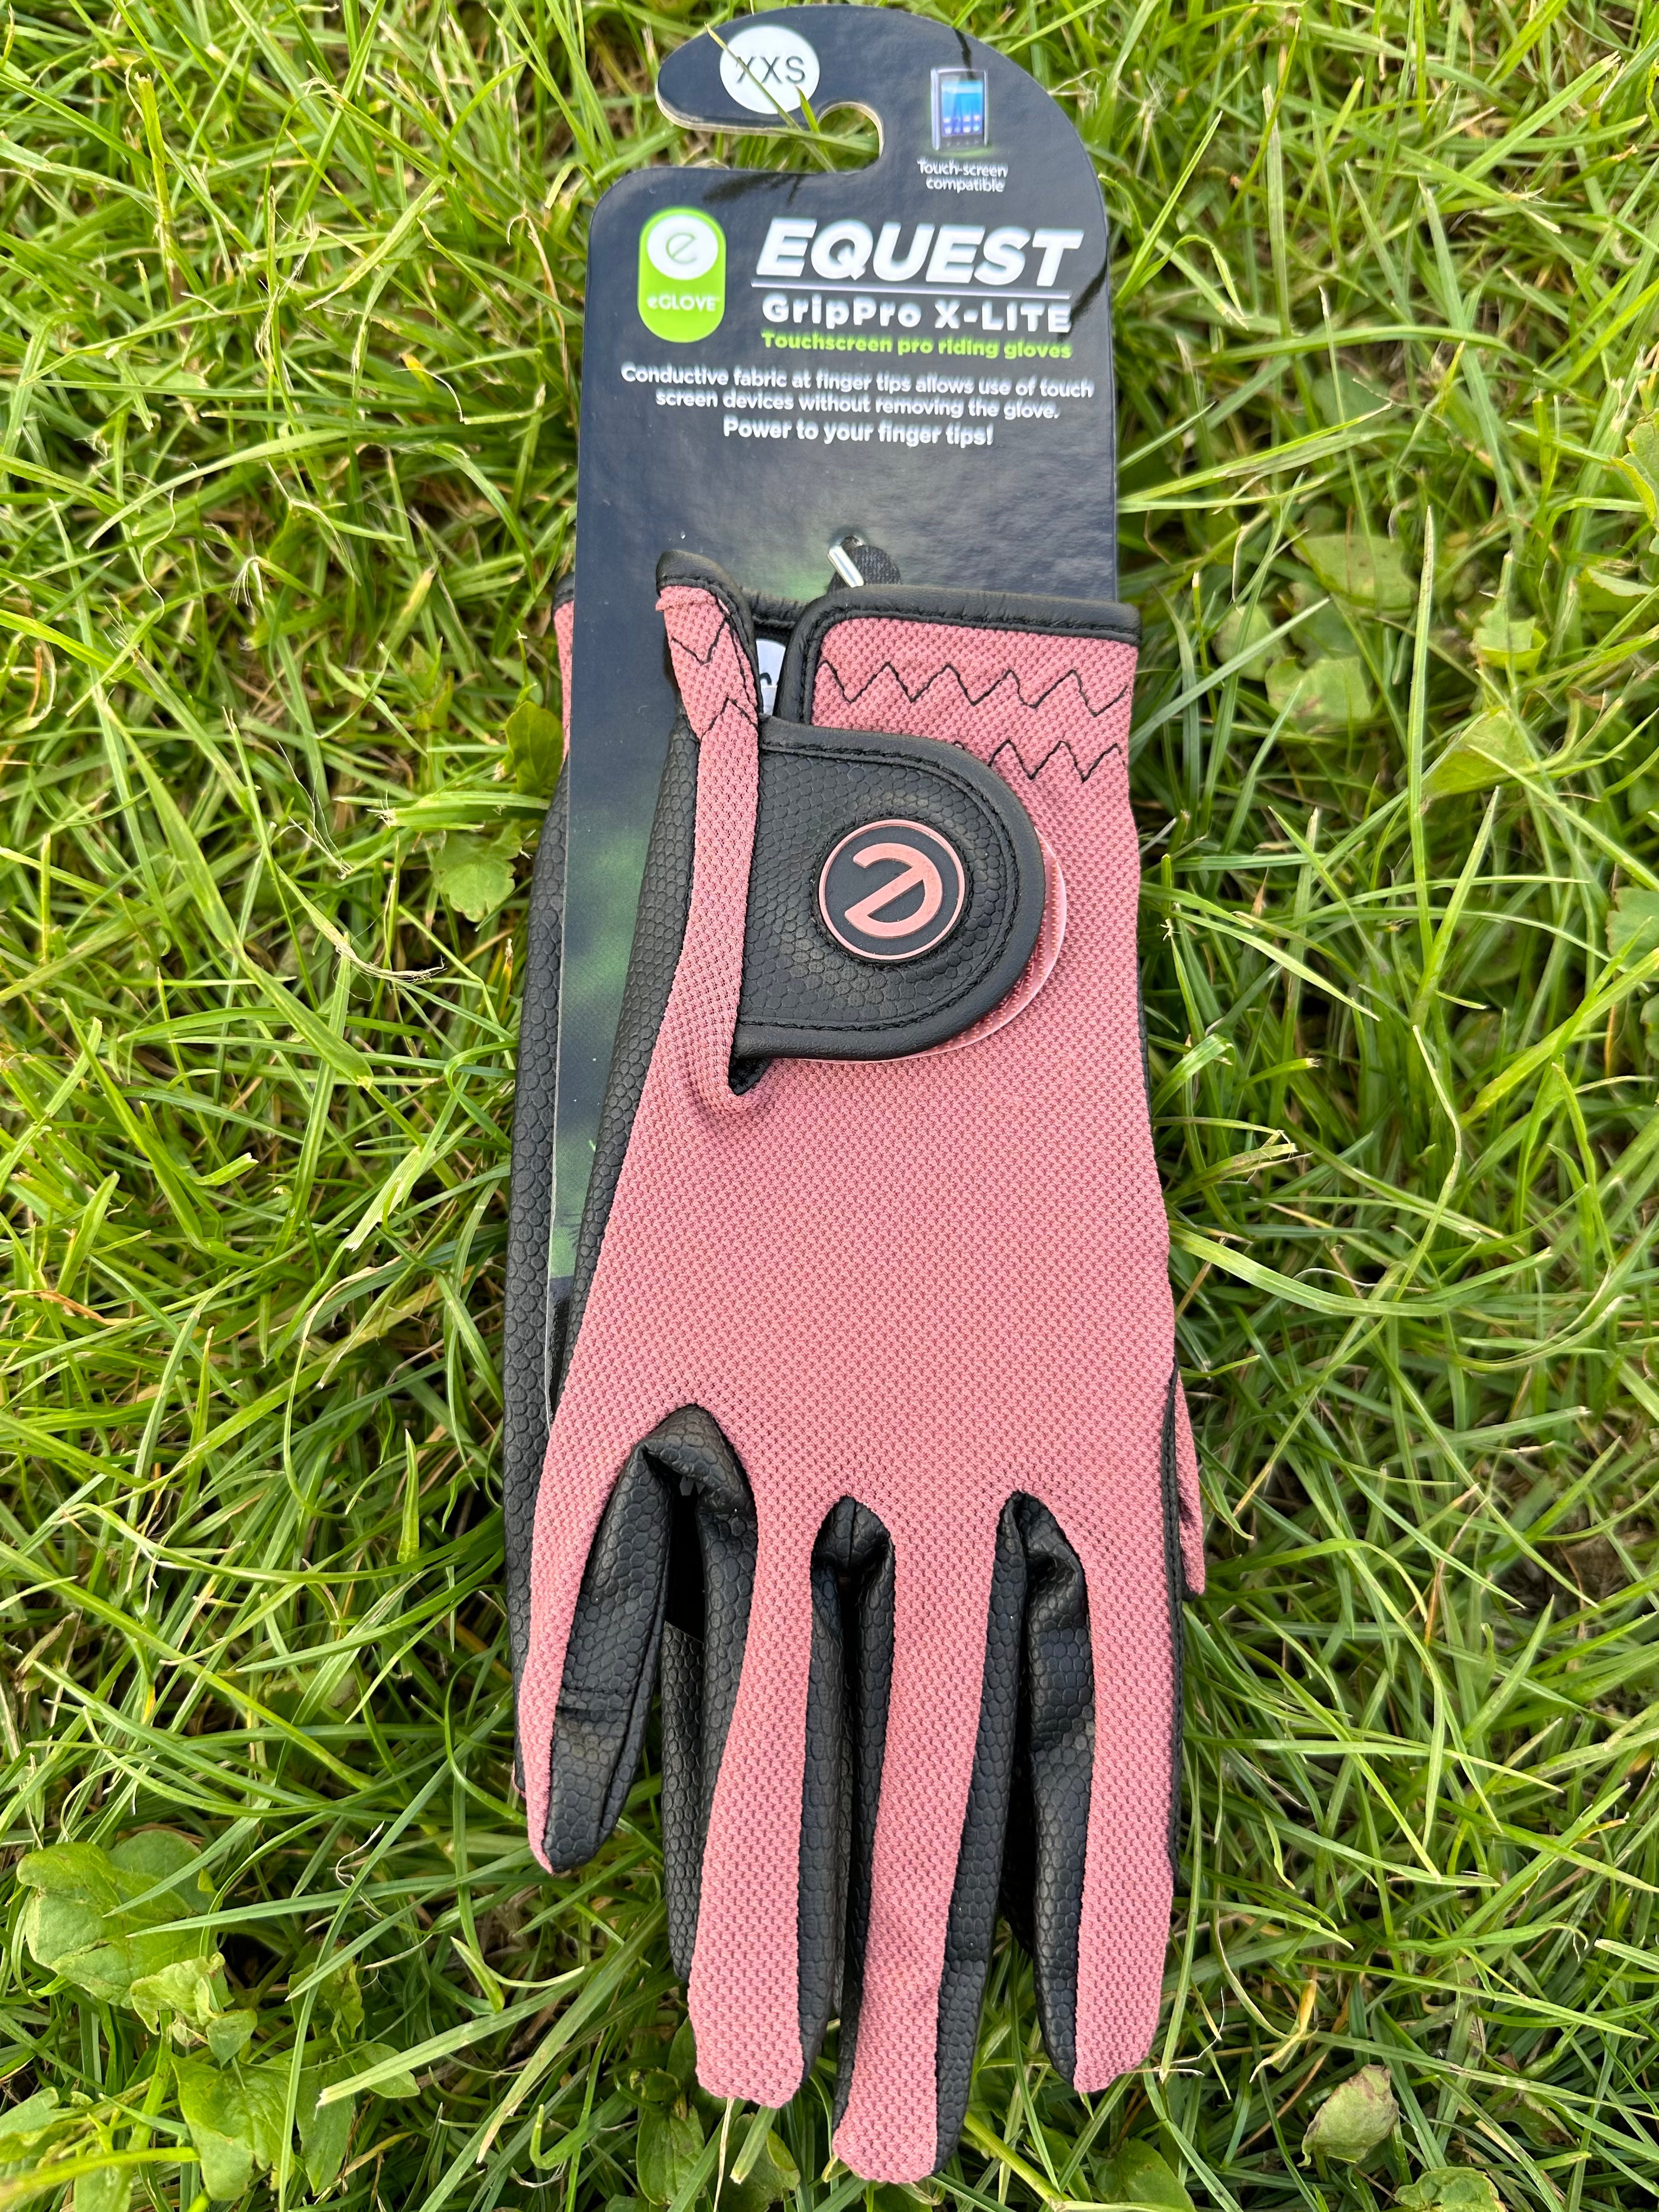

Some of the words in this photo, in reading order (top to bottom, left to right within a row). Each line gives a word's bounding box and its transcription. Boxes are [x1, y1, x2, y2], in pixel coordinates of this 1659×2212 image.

[735, 55, 805, 84] XXS
[917, 157, 1008, 177] Touch-screen
[926, 176, 1005, 193] compatible
[756, 216, 1084, 287] EQUEST
[762, 293, 922, 329] GripPro
[934, 298, 1072, 333] X-LITE
[761, 328, 892, 353] Touchscreen
[897, 337, 933, 355] pro
[938, 337, 999, 359] riding
[1004, 339, 1072, 359] gloves
[620, 362, 729, 385] Conductive
[733, 365, 787, 387] fabric
[792, 369, 811, 388] at
[815, 368, 872, 392] finger
[876, 371, 911, 394] tips
[915, 372, 974, 394] allows
[978, 377, 1012, 395] use
[1015, 375, 1037, 396] of
[1040, 377, 1094, 398] touch
[655, 388, 718, 407] screen
[722, 388, 794, 410] devices
[798, 391, 871, 413] without
[876, 395, 964, 419] removing
[968, 397, 1000, 417] the
[1003, 398, 1061, 420] glove.
[723, 414, 792, 439] Power
[796, 418, 818, 440] to
[824, 421, 873, 445] your
[877, 420, 942, 447] finger
[945, 422, 993, 448] tips!
